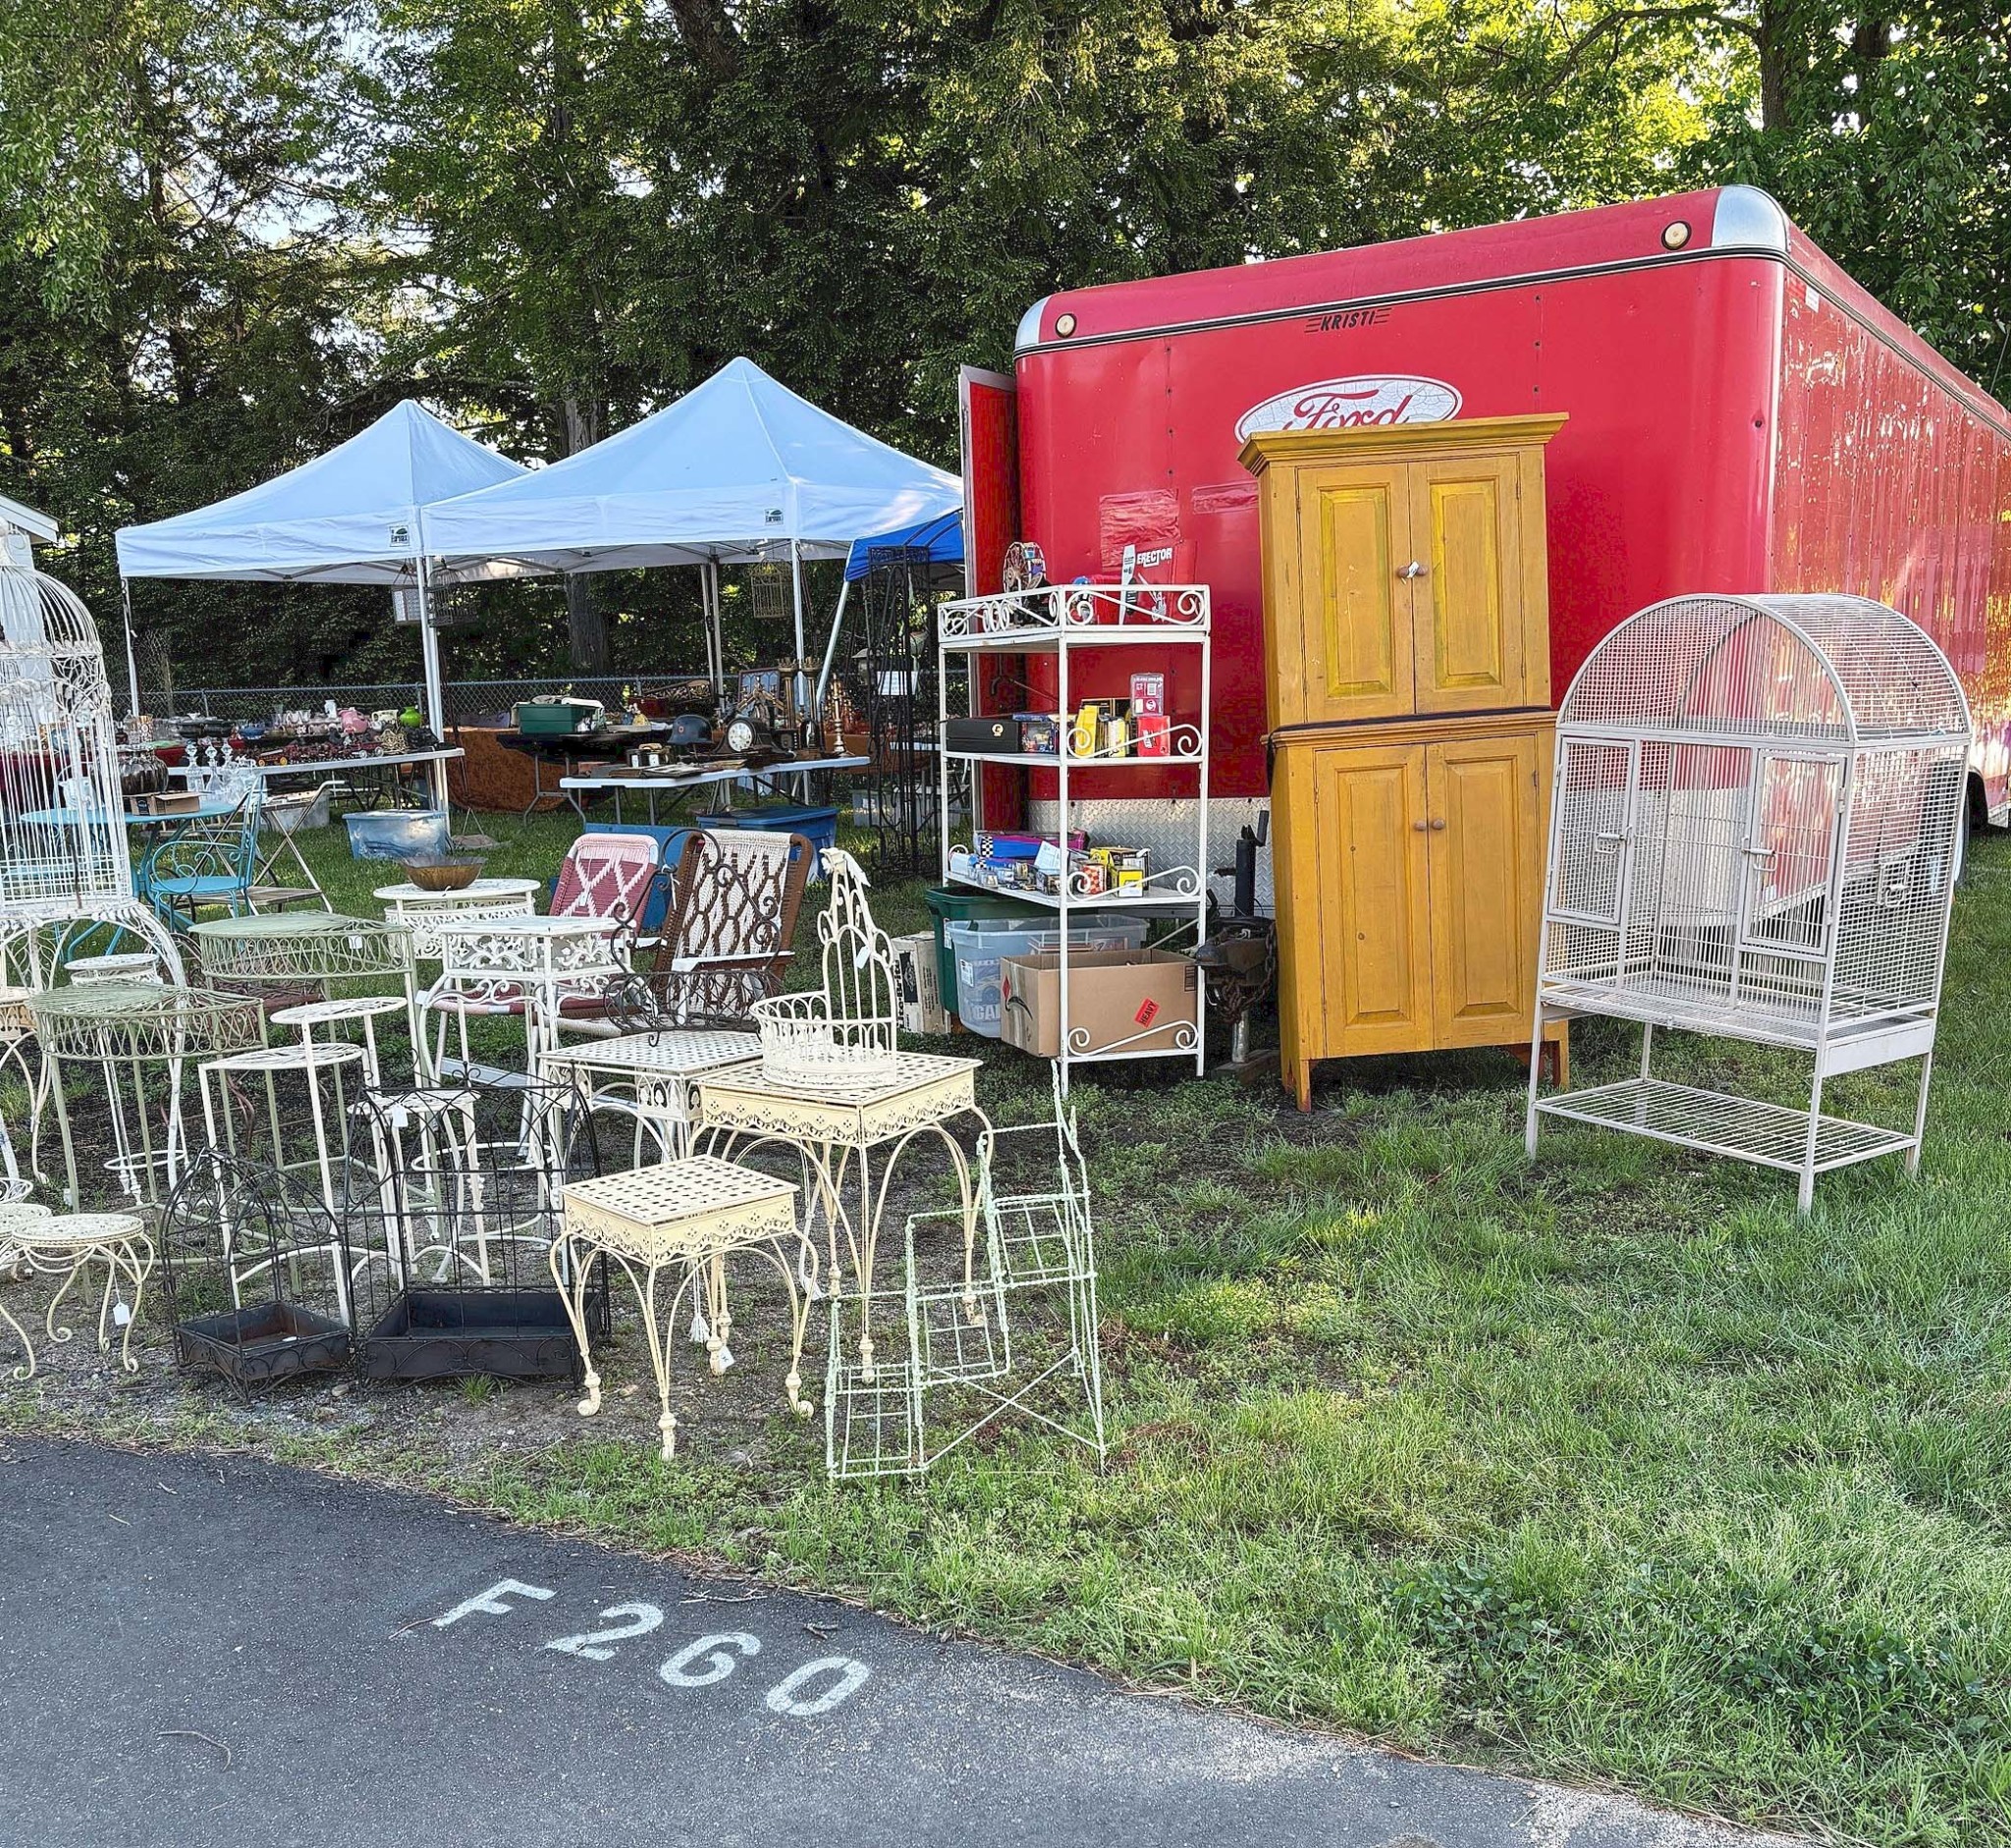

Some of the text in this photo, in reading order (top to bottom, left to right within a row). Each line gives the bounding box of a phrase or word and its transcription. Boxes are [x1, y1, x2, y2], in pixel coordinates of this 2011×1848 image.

[1321, 310, 1375, 331] KRISTI
[1282, 389, 1412, 429] Ford
[1136, 547, 1172, 568] ERECTOR
[1139, 1001, 1157, 1027] HEAVY
